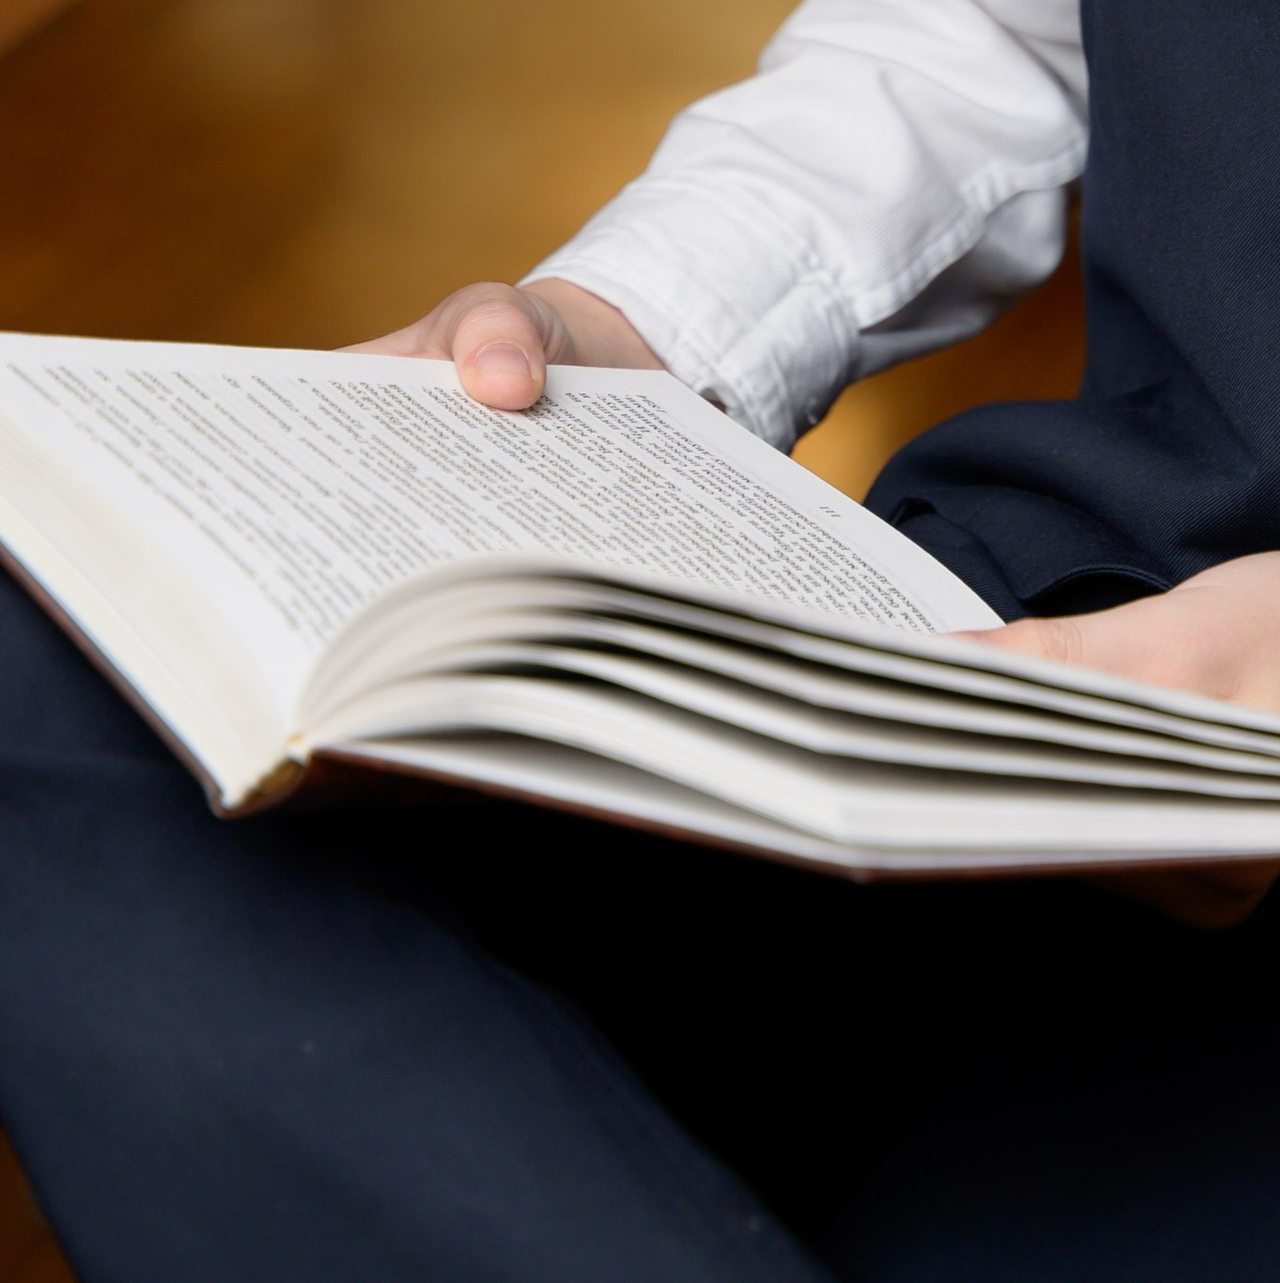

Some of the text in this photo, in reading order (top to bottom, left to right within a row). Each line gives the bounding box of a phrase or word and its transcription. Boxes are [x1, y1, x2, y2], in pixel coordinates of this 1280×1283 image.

[564, 392, 582, 402] на
[595, 393, 620, 411] пус-
[625, 394, 674, 430] людьми.
[581, 404, 619, 430] пятно
[591, 401, 642, 439] Челкаша
[607, 393, 692, 452] воспоминание
[620, 412, 638, 424] на
[620, 432, 670, 464] красное
[648, 442, 687, 467] следы
[672, 431, 713, 456] двумя
[671, 466, 714, 495] смыли
[688, 469, 731, 497] смыли
[705, 462, 749, 490] ничего
[710, 457, 753, 483] между
[701, 468, 780, 521] прибрежном
[737, 499, 784, 537] Челкаш,
[752, 492, 805, 529] осталось
[753, 485, 849, 550] разыгравшейся
[748, 519, 794, 552] брызги
[781, 523, 799, 534] на
[806, 531, 824, 543] не
[790, 541, 832, 572] лежал
[799, 536, 839, 566] парня
[825, 545, 858, 570] моря
[851, 552, 891, 585] драме,
[839, 568, 895, 618] молодого
[859, 573, 899, 608] берегу
